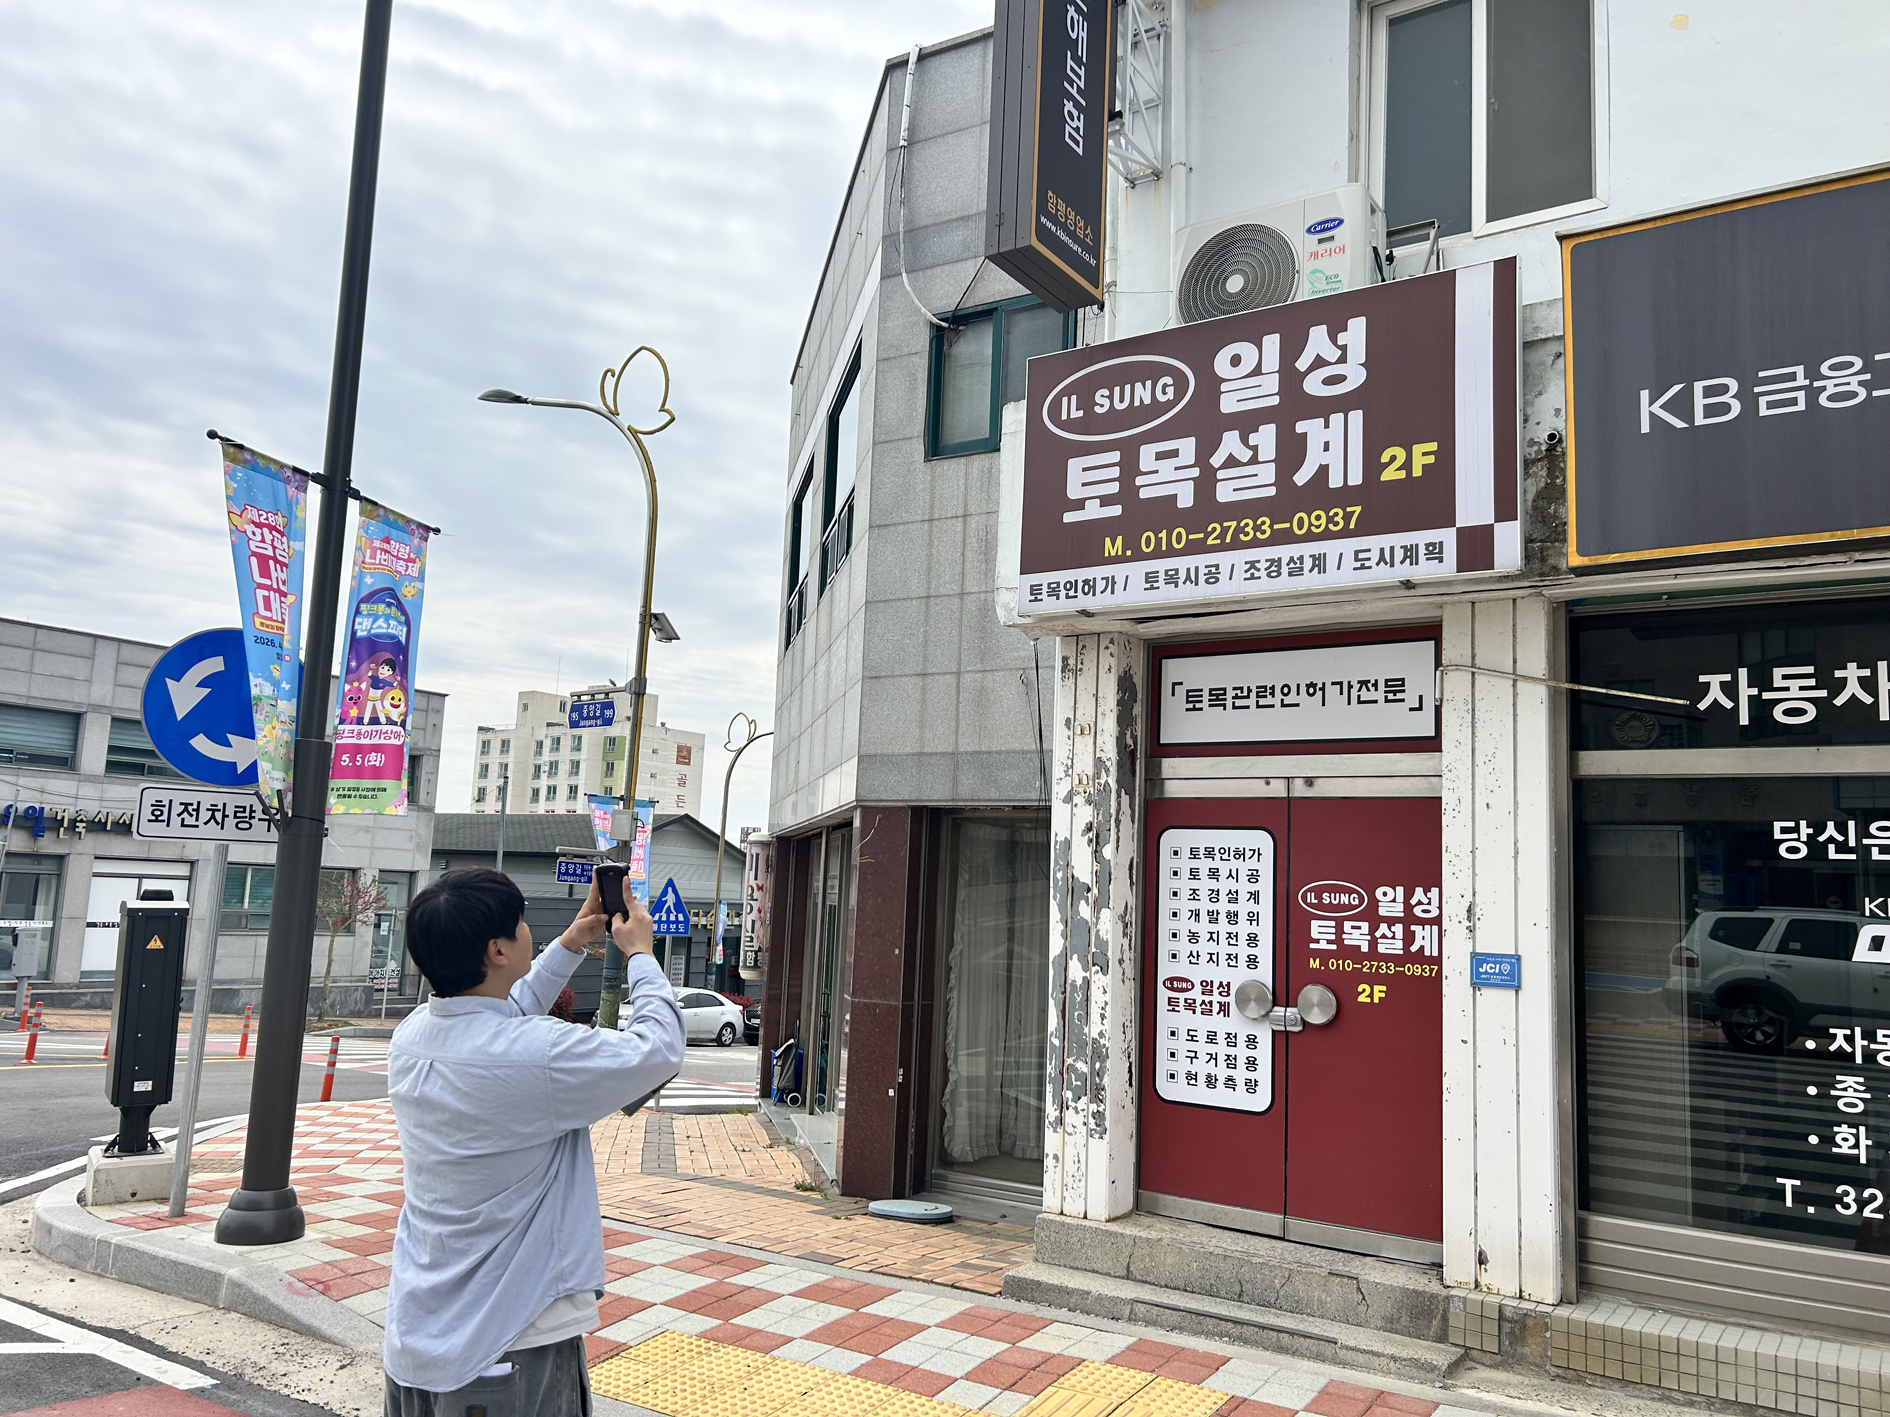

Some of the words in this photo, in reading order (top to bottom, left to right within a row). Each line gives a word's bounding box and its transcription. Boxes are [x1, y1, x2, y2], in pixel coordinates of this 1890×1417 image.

[1063, 0, 1089, 157] 해보험
[1047, 189, 1094, 246] 함평영업소
[1310, 219, 1340, 233] Carrier
[1039, 213, 1097, 267] www.kbinsure.co.kr
[1307, 244, 1346, 261] 캐리어
[1310, 286, 1341, 296] Inverter
[1213, 316, 1367, 413] 일성
[1061, 395, 1084, 420] IL
[1093, 376, 1174, 413] SUNG
[1063, 409, 1363, 523] 토목설계
[1380, 441, 1438, 481] 2F
[1104, 535, 1132, 557] M.
[1140, 505, 1362, 553] 010-2733-0937
[1028, 575, 1117, 602] 토목인허가
[1143, 563, 1221, 591] 토목시공
[1243, 552, 1327, 582] 조경설계
[1352, 540, 1444, 571] 도시계획
[354, 616, 407, 644] 댄스파티
[582, 703, 602, 717] 중앙길
[1187, 846, 1263, 863] 토목인허가
[560, 863, 582, 874] 중앙길
[1306, 891, 1318, 904] IL
[1321, 892, 1359, 905] SUNG
[1374, 885, 1440, 918] 일성
[1865, 897, 1890, 917] K
[1309, 919, 1439, 957] 토목설계
[1309, 957, 1325, 970] M.
[1328, 958, 1439, 977] 010-2733-0937
[1478, 963, 1500, 973] JCI
[1173, 981, 1192, 989] SUNG
[1199, 979, 1231, 998] 일성
[1356, 983, 1387, 1003] 2F
[1166, 996, 1230, 1018] 토목설계
